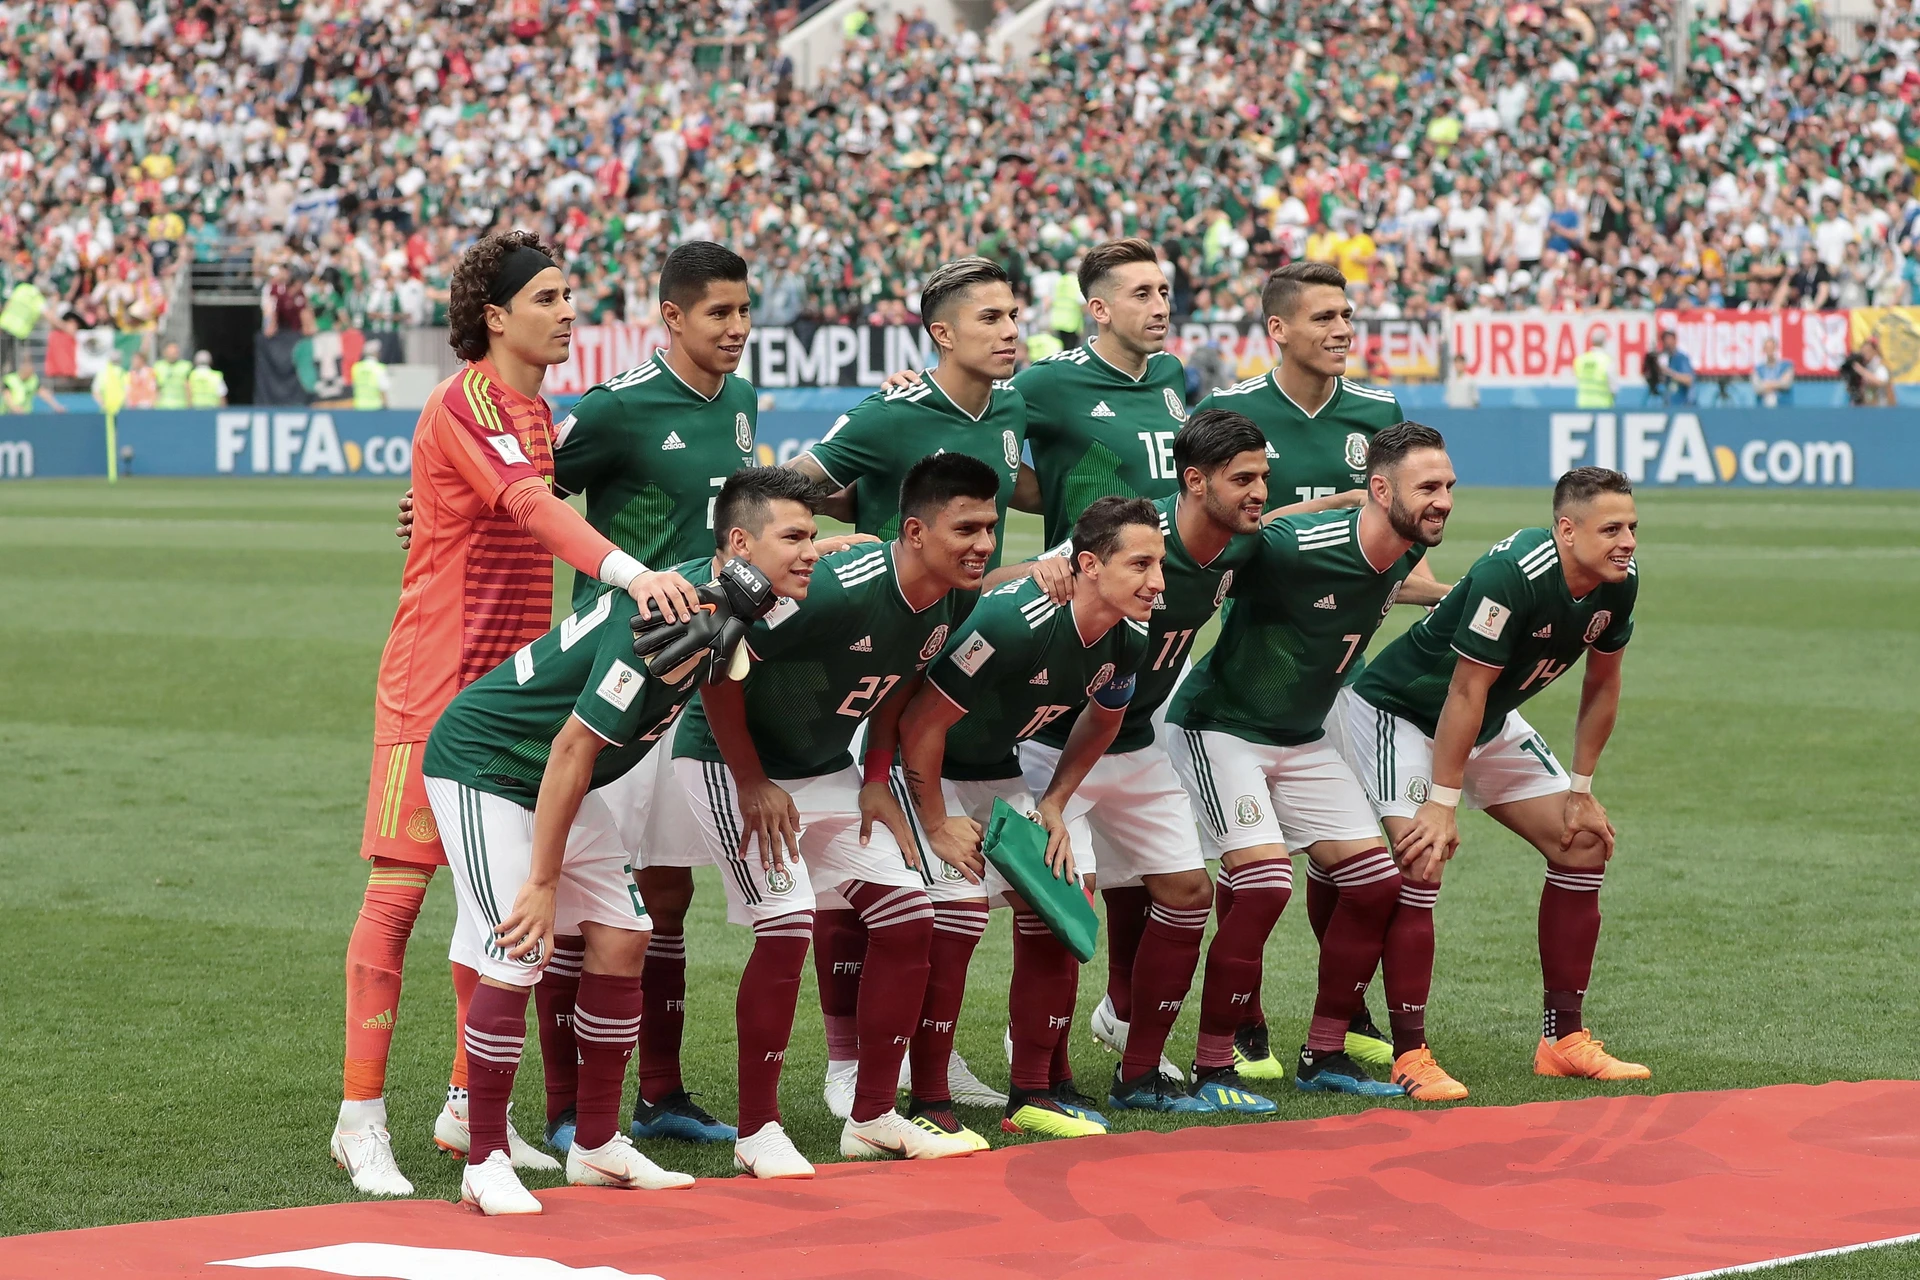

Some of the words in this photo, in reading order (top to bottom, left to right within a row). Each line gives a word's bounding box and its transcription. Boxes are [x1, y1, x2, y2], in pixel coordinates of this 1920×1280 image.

[216, 412, 412, 478] FIFA.co
[1335, 634, 1362, 674] 7
[1518, 658, 1568, 691] 14
[833, 962, 863, 975] FMF
[1230, 992, 1252, 1005] FM
[556, 1013, 574, 1027] FM
[922, 1018, 953, 1034] FMF
[1049, 1015, 1070, 1030] FMF
[764, 1051, 784, 1061] FM
